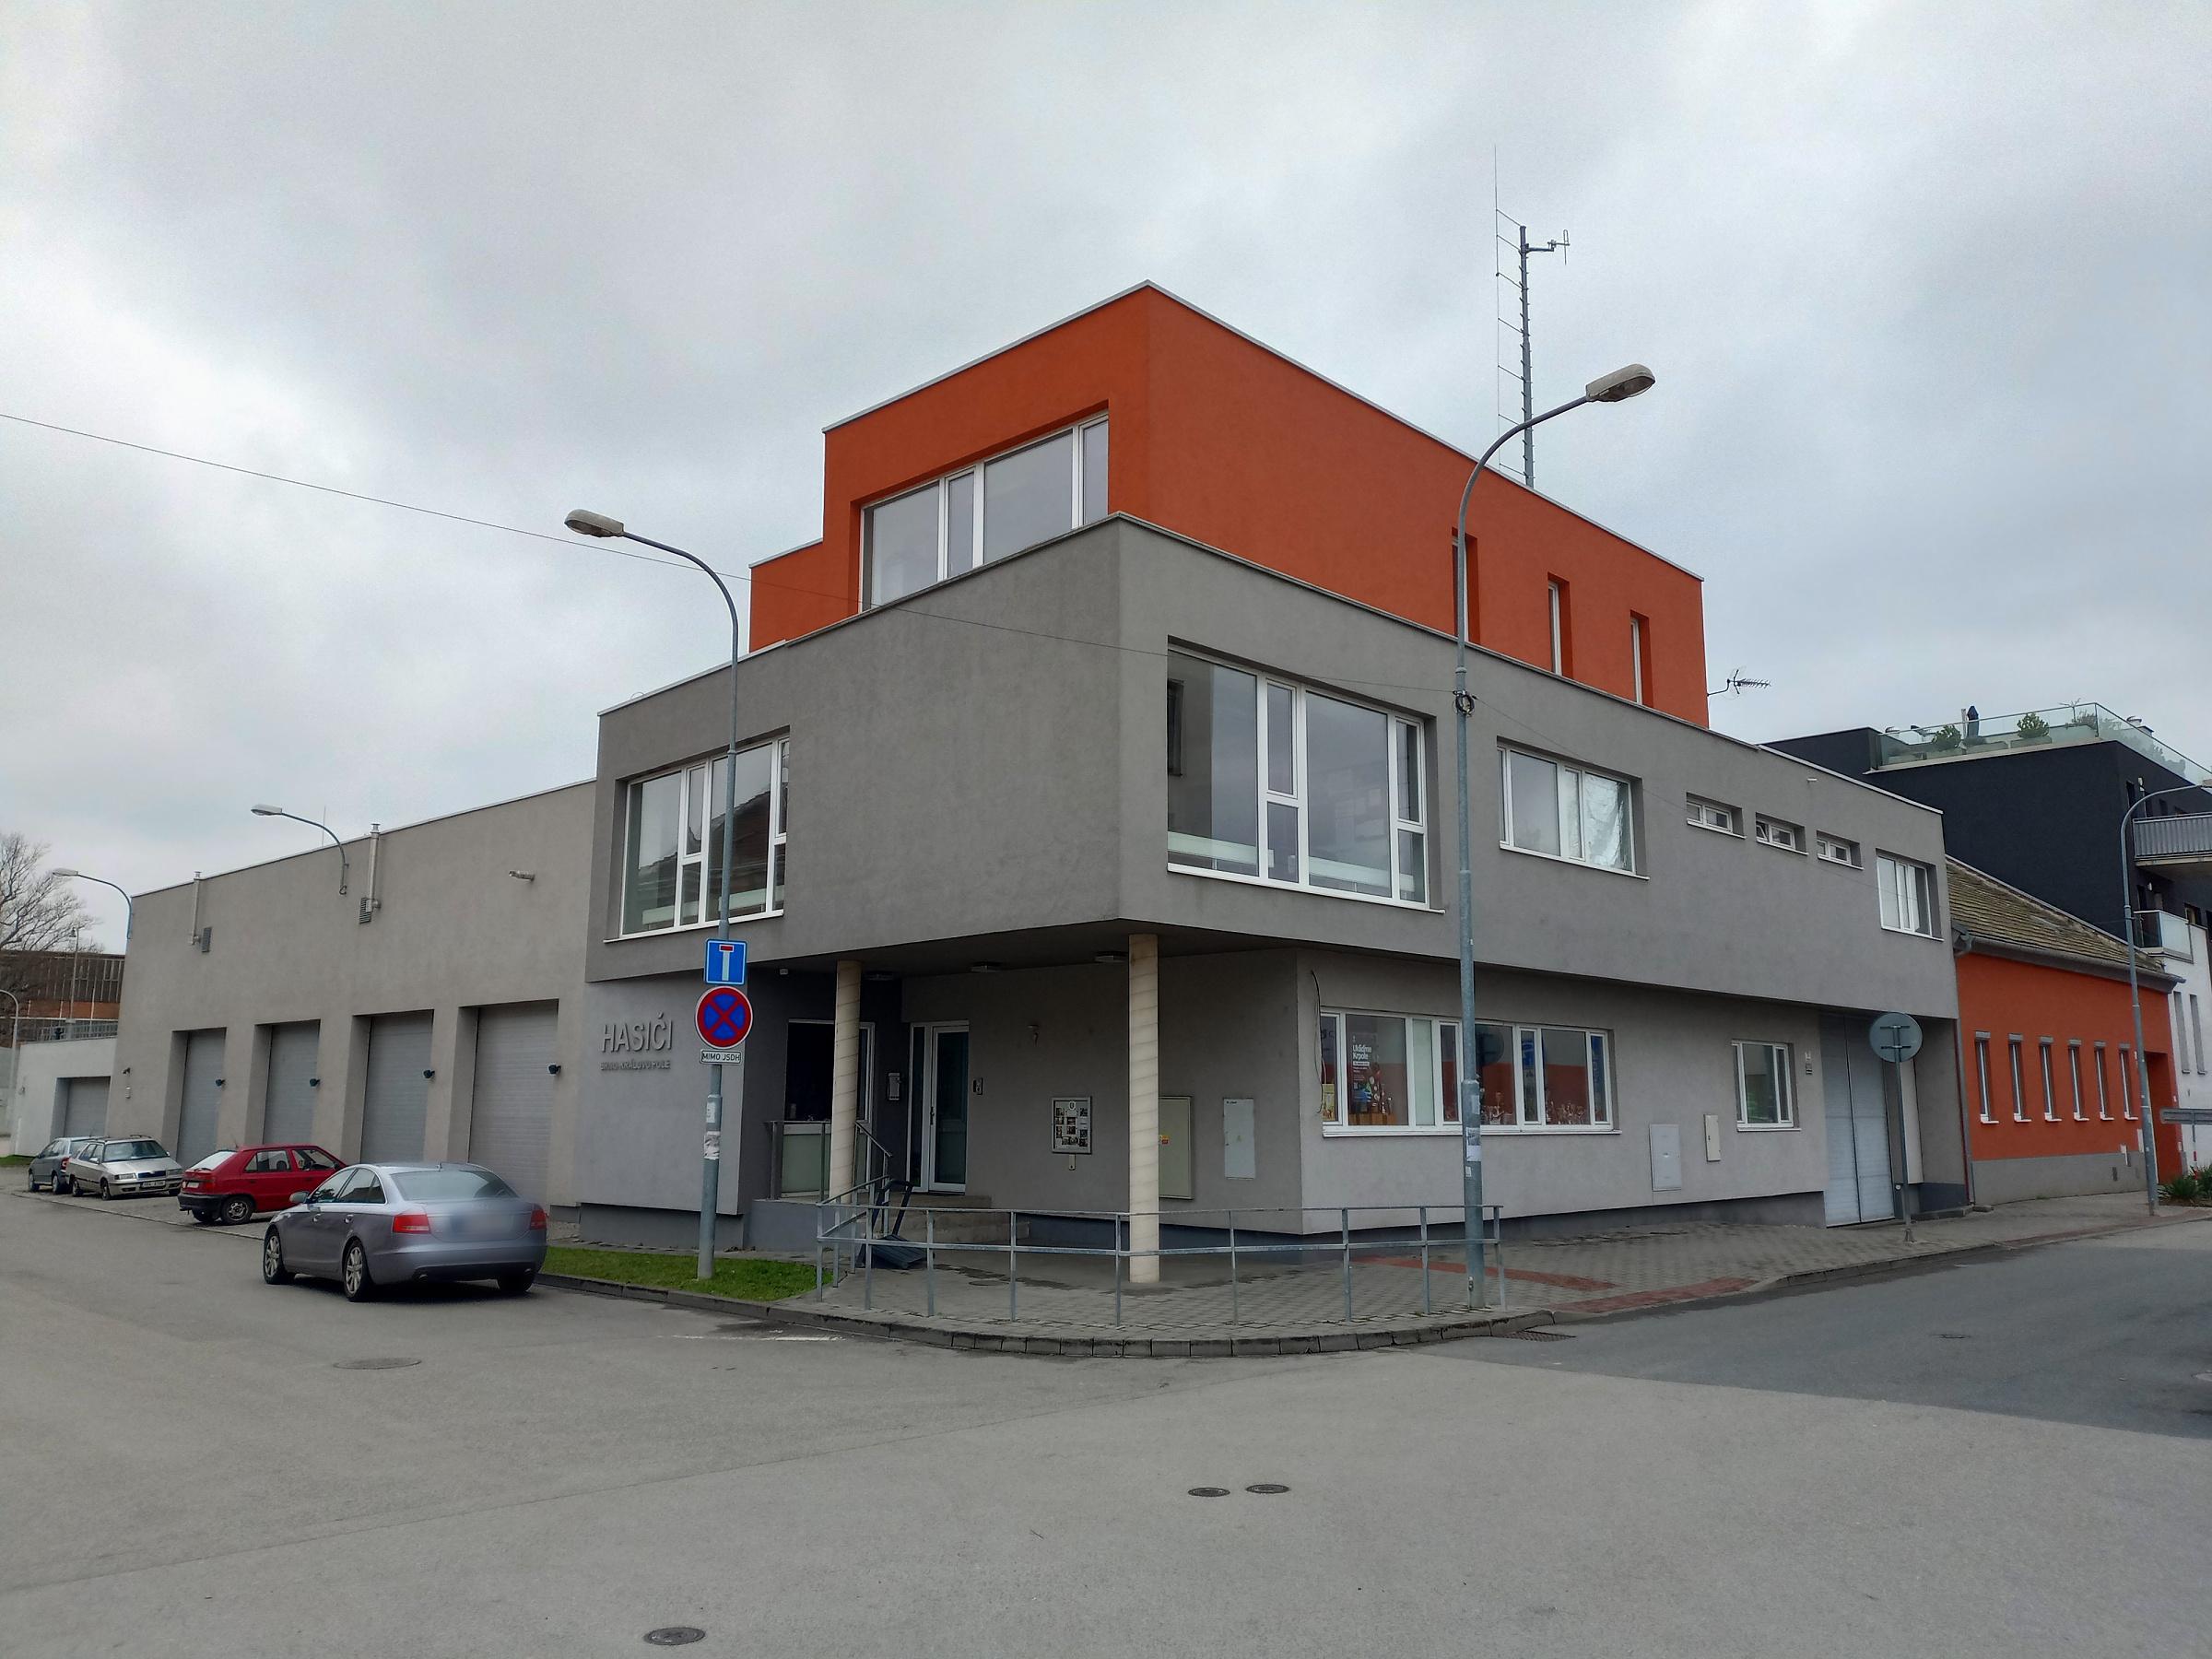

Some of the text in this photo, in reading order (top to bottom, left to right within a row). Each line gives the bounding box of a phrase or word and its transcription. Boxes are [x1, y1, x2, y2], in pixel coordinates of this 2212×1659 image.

[603, 1012, 673, 1053] HASIČI
[702, 1053, 740, 1062] MIMO JSDH
